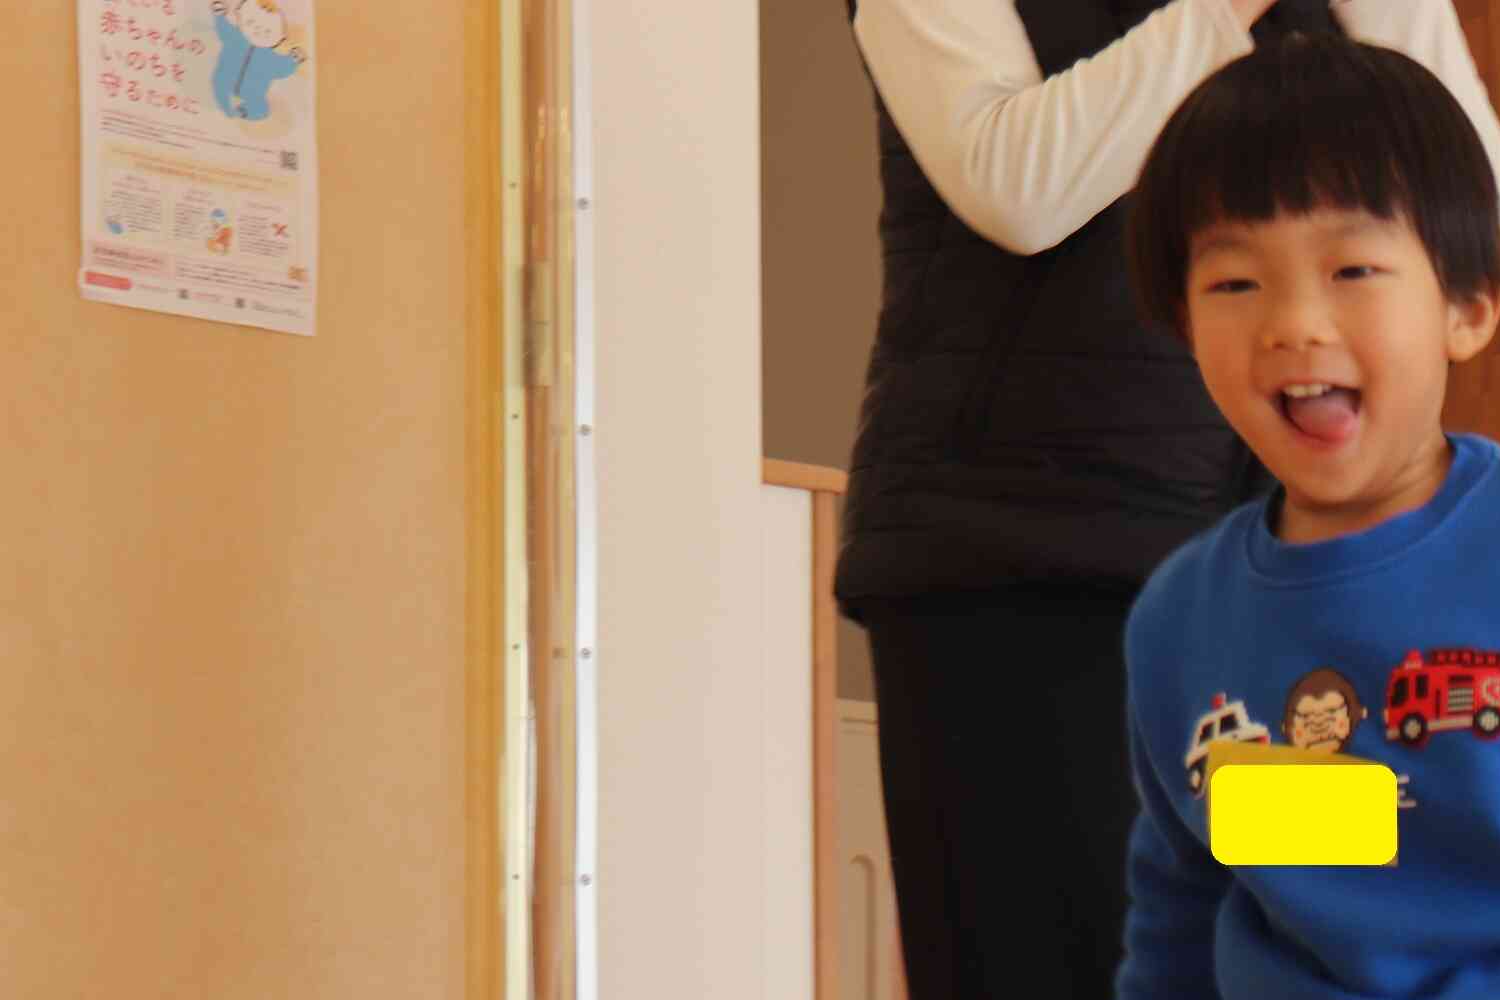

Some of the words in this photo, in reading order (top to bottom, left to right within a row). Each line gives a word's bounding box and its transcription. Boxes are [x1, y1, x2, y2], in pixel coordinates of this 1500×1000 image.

[101, 9, 206, 55] 赤ちゃんの
[101, 43, 186, 81] いのちを
[98, 71, 201, 114] 守るために
